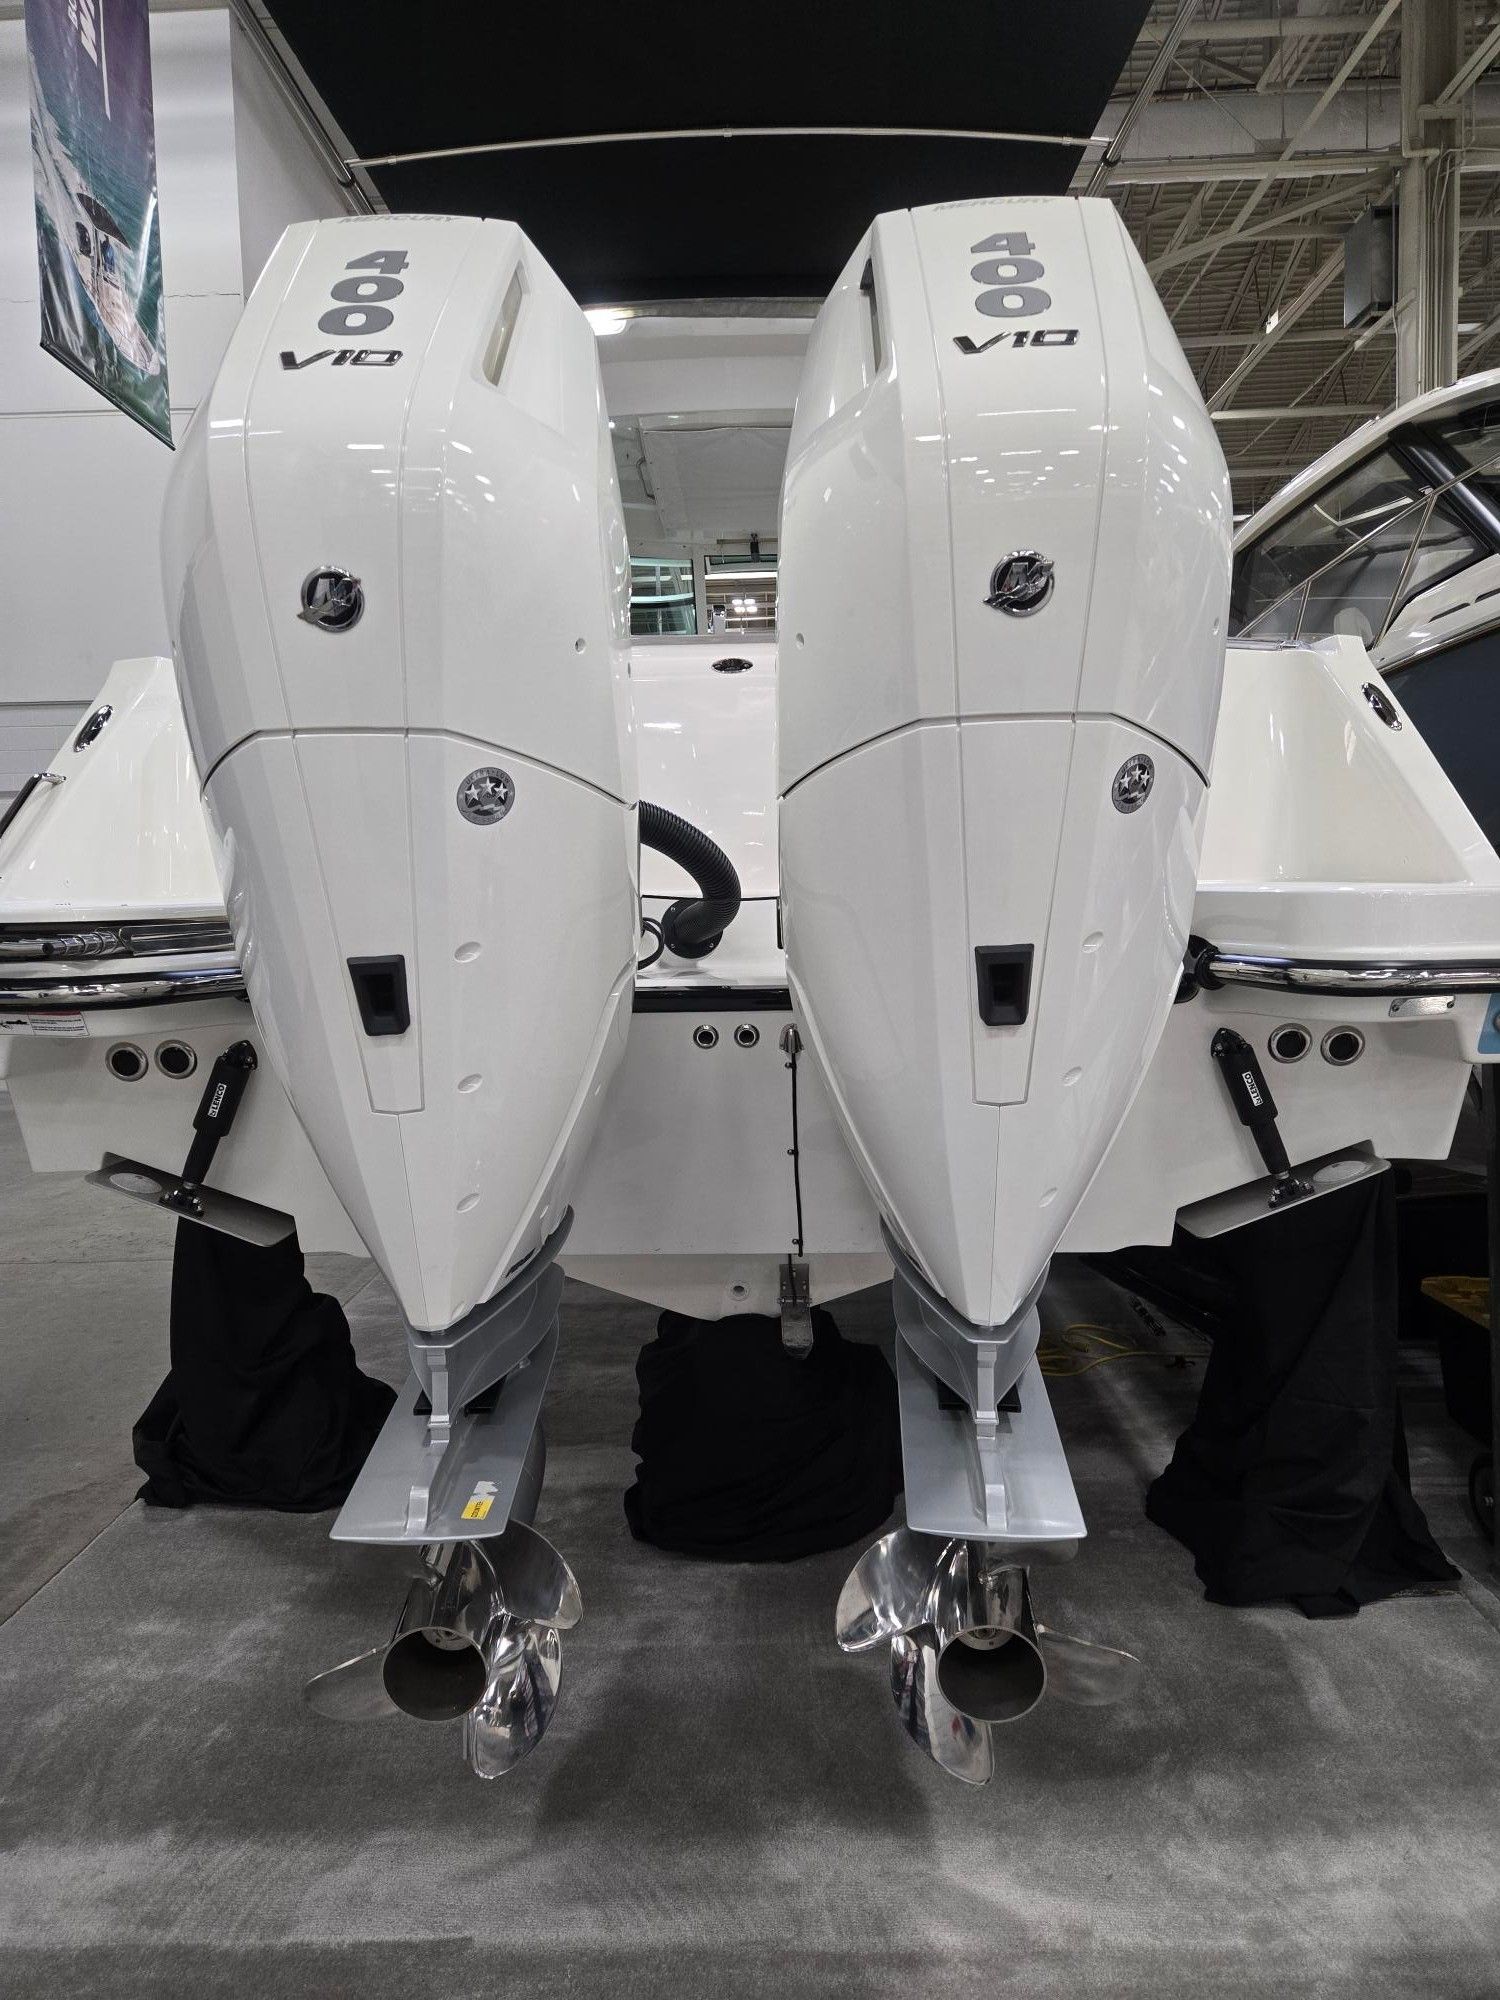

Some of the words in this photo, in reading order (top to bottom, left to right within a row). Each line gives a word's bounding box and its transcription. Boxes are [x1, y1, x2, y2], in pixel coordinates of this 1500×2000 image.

[970, 231, 1051, 318] 400
[318, 249, 410, 336] 400
[952, 329, 1080, 355] V10
[279, 349, 404, 371] V10
[211, 1084, 226, 1111] LENCO
[1244, 1072, 1261, 1100] LENCO
